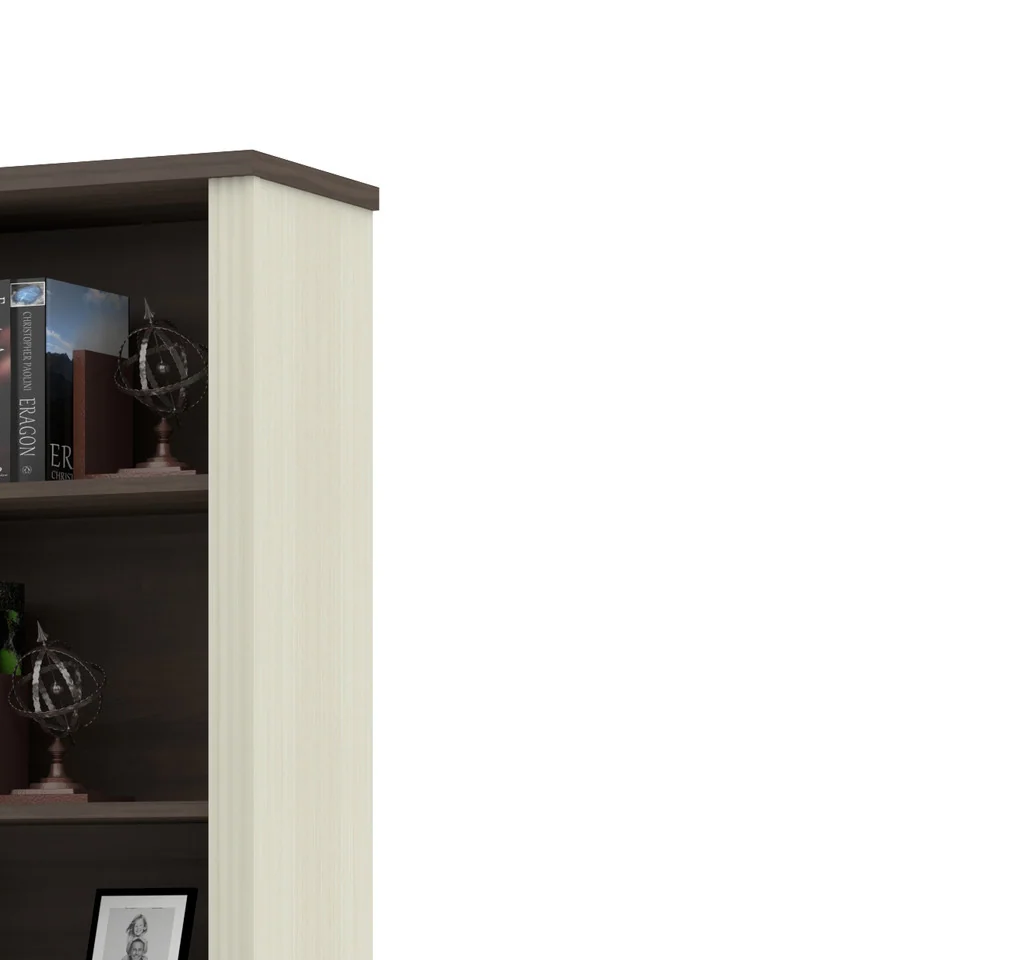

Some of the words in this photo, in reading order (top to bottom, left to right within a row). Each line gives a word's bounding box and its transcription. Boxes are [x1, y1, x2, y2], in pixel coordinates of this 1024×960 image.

[23, 311, 32, 361] CHRISTOPHER
[23, 362, 32, 391] PAOLINI
[19, 397, 36, 456] ERAGON
[50, 443, 74, 470] ER
